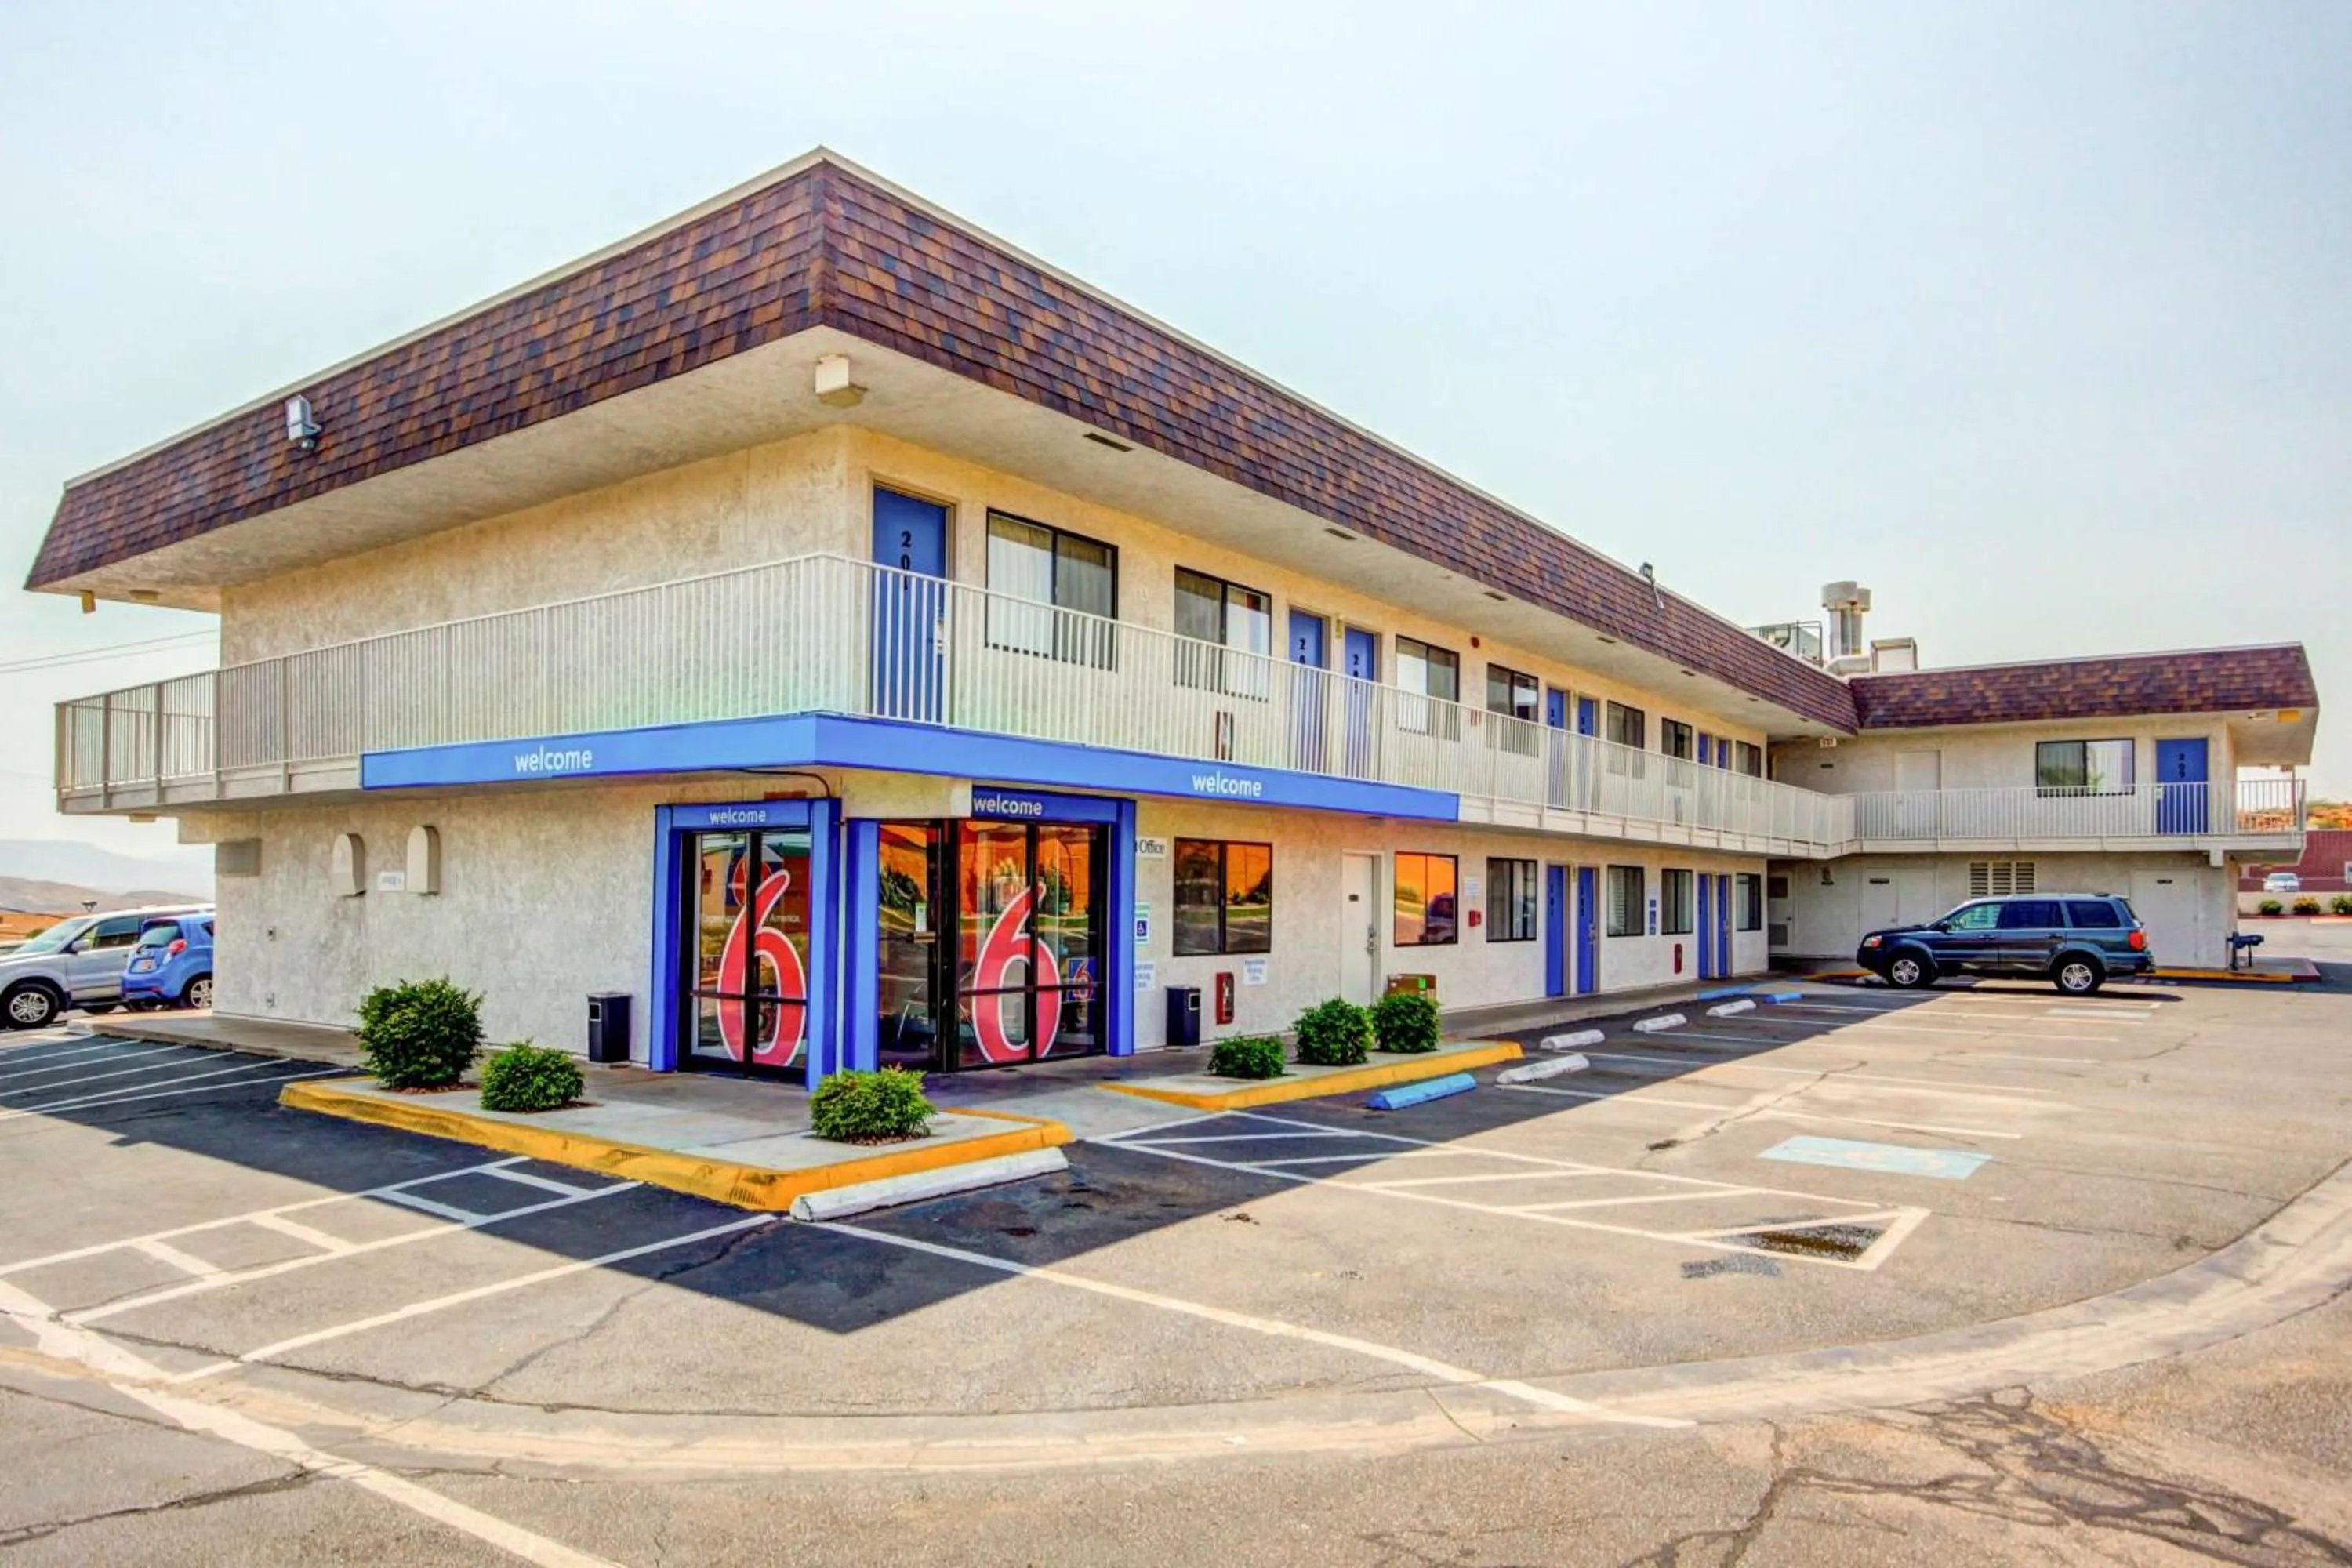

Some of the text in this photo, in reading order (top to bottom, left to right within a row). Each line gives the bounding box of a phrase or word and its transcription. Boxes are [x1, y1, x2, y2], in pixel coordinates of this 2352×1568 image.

[514, 743, 593, 772] welcome
[1192, 769, 1262, 797] welcome
[709, 807, 767, 825] welcome
[973, 793, 1043, 816] welcome
[1139, 839, 1164, 854] Office
[717, 869, 807, 1067] 6
[971, 879, 1062, 1063] 6
